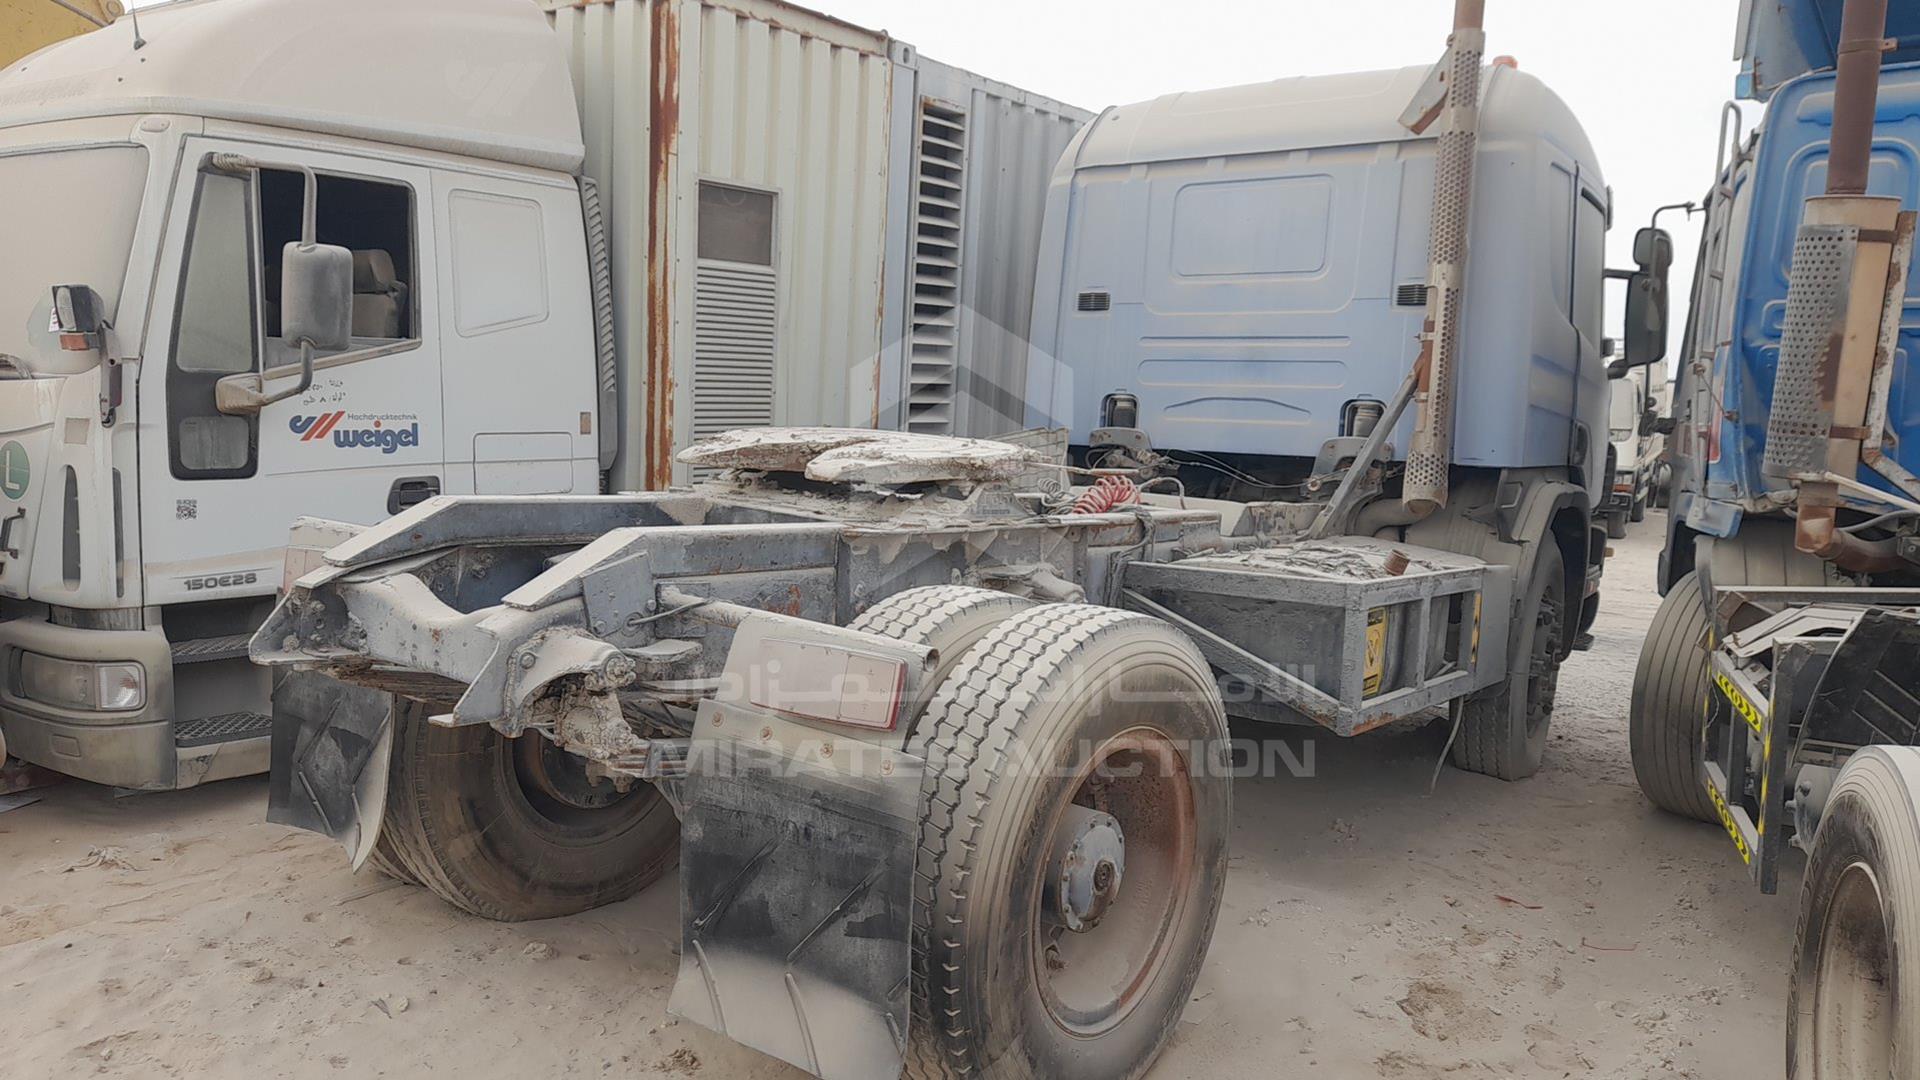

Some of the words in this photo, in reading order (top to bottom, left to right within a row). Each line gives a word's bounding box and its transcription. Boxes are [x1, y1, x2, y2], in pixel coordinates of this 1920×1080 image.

[346, 413, 418, 422] Hochdrucktechnik
[333, 420, 419, 454] weigel
[5, 450, 21, 490] L
[183, 572, 258, 591] 150E28
